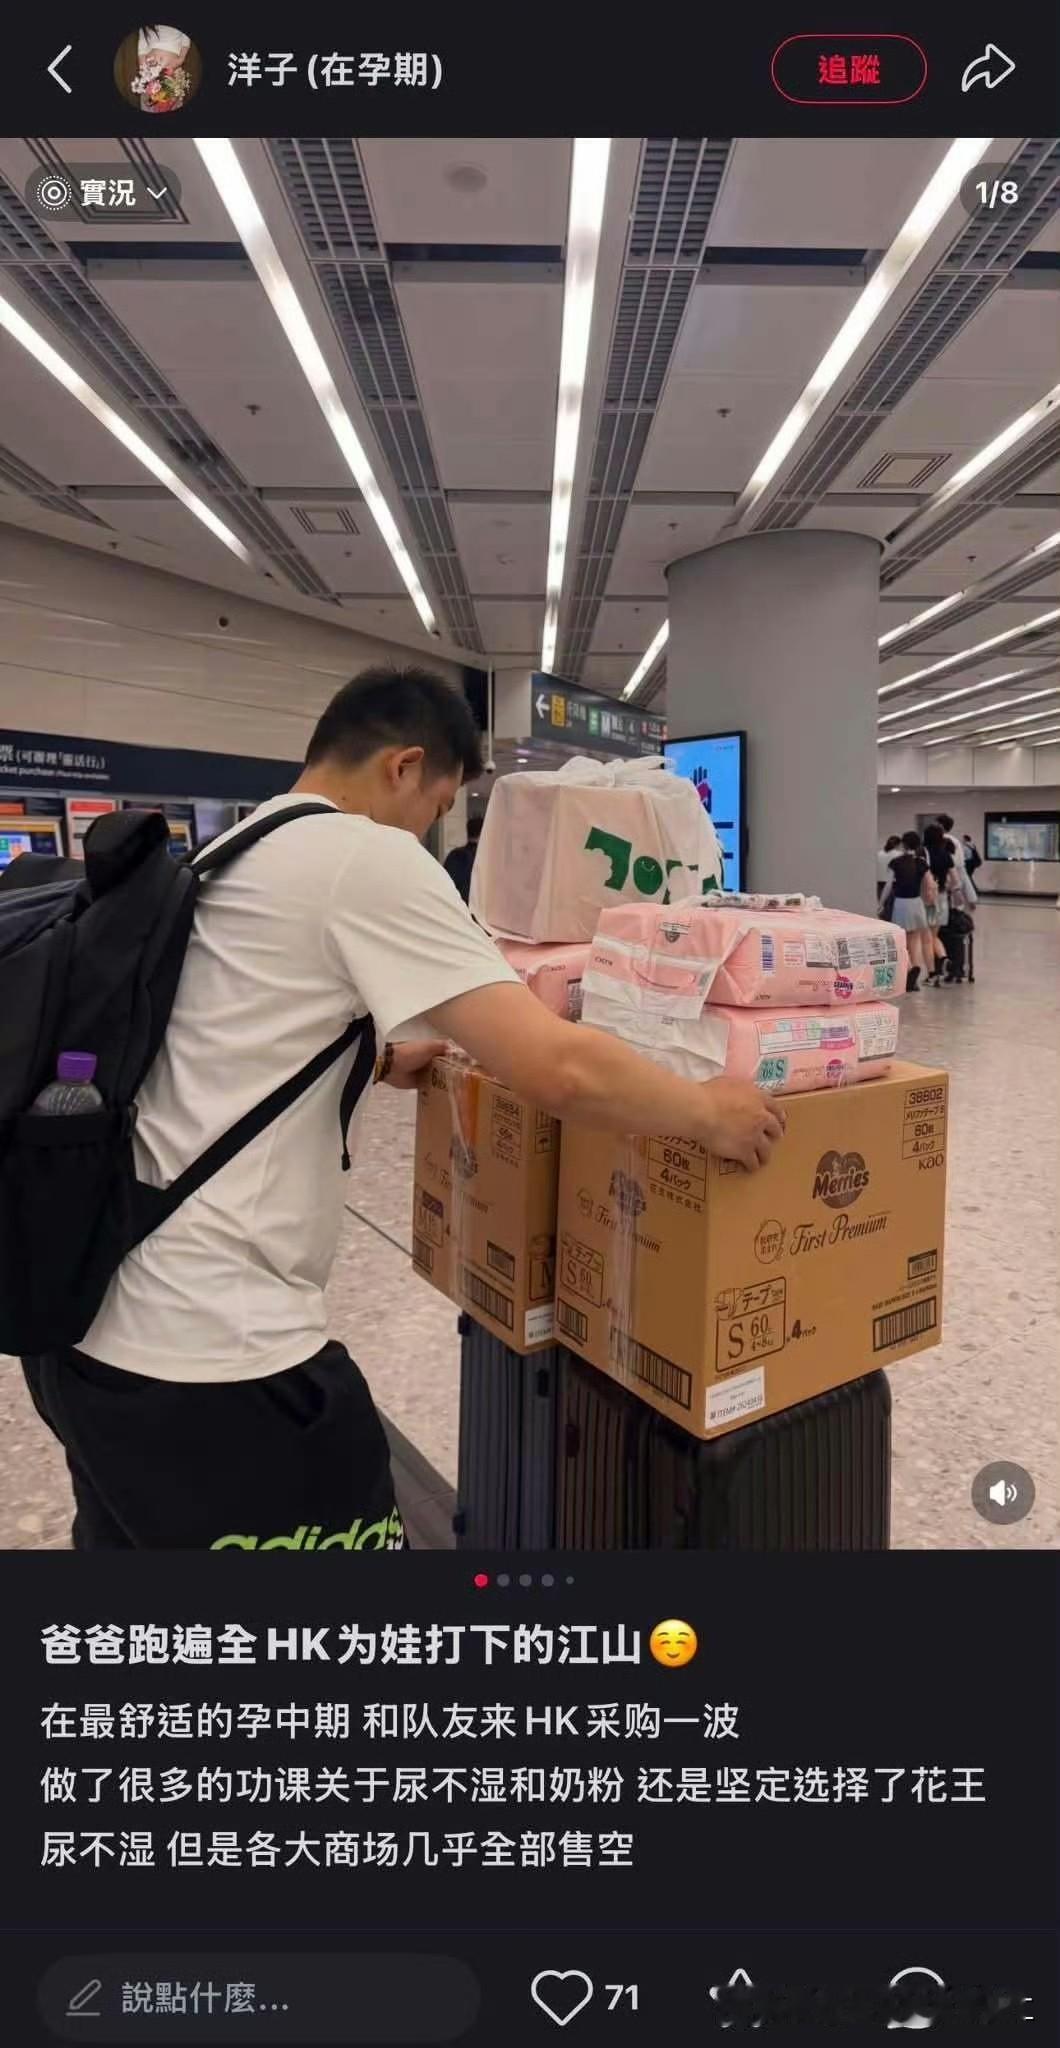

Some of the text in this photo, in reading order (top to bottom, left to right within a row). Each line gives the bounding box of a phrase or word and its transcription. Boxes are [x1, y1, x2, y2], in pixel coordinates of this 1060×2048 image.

[812, 1170, 870, 1200] Merries
[790, 1222, 828, 1256] First
[828, 1212, 890, 1245] Premium
[727, 1322, 745, 1359] S
